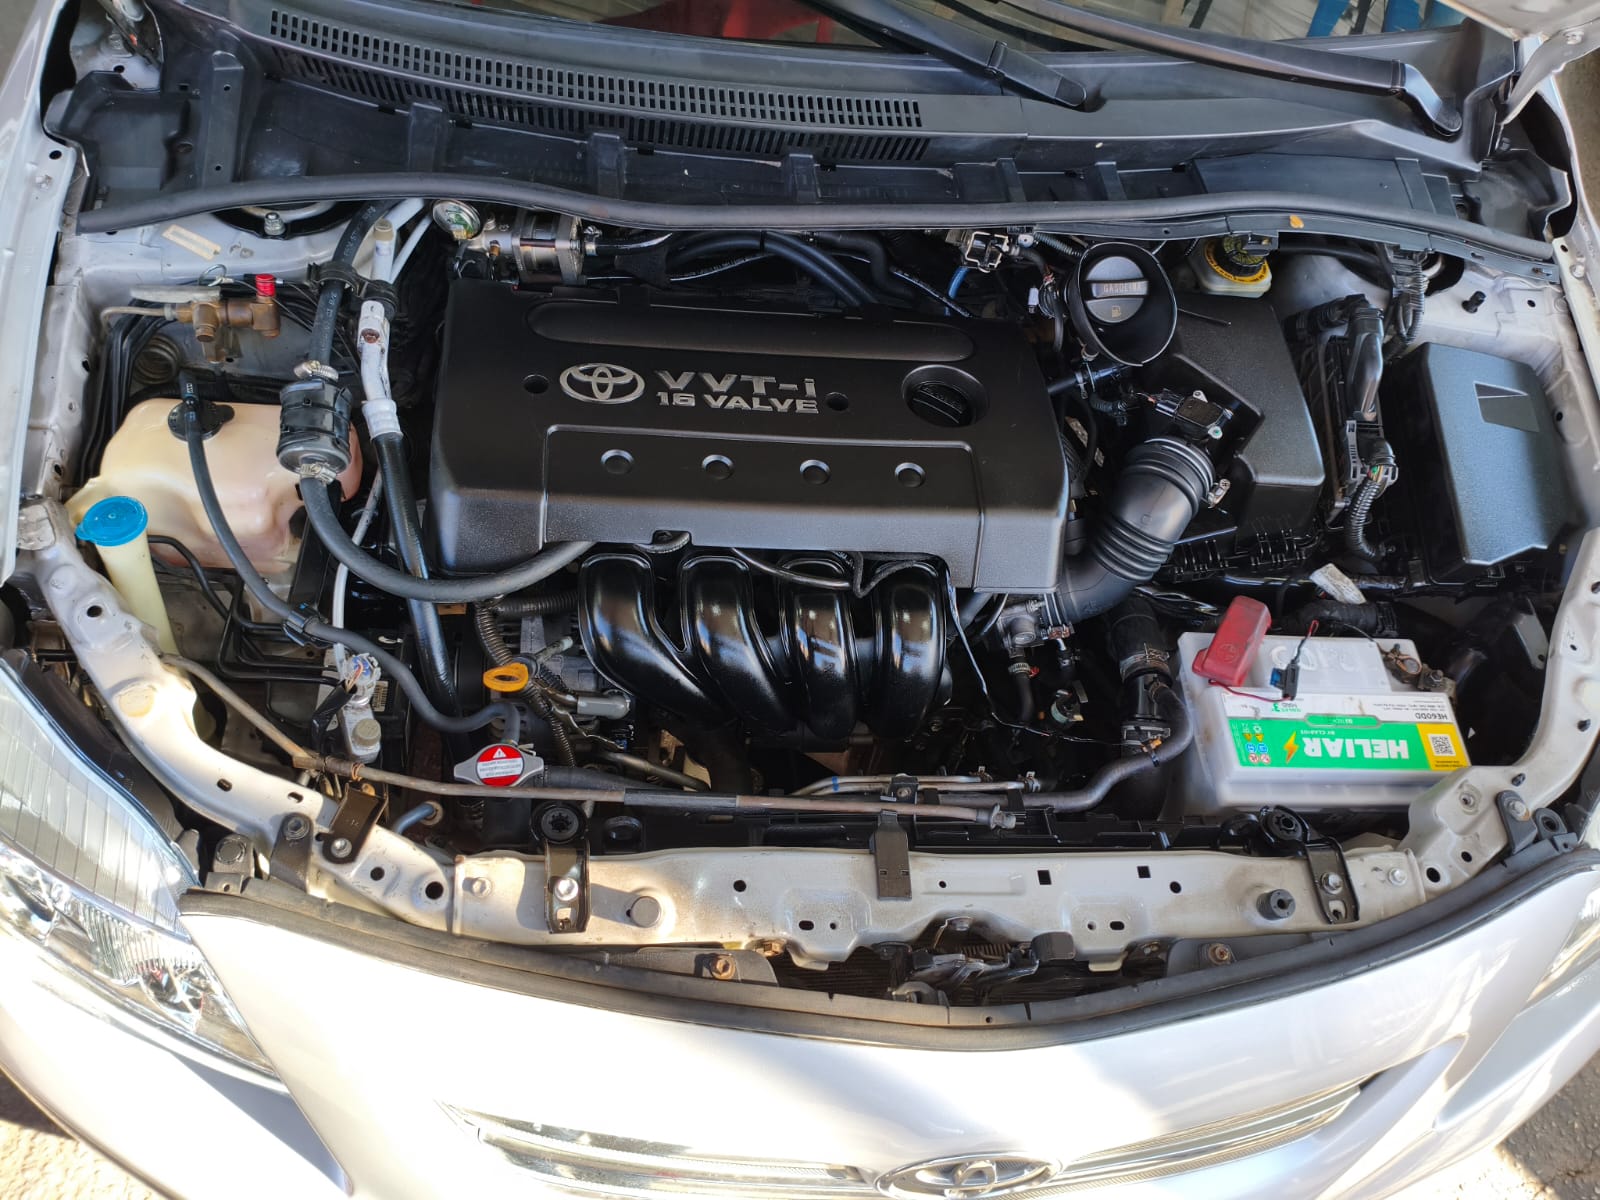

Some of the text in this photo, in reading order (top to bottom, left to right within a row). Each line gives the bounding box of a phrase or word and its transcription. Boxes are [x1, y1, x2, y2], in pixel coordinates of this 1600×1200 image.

[655, 370, 817, 398] VVT-i
[656, 391, 819, 414] 16 VALVE
[1303, 737, 1409, 759] HELIAR
